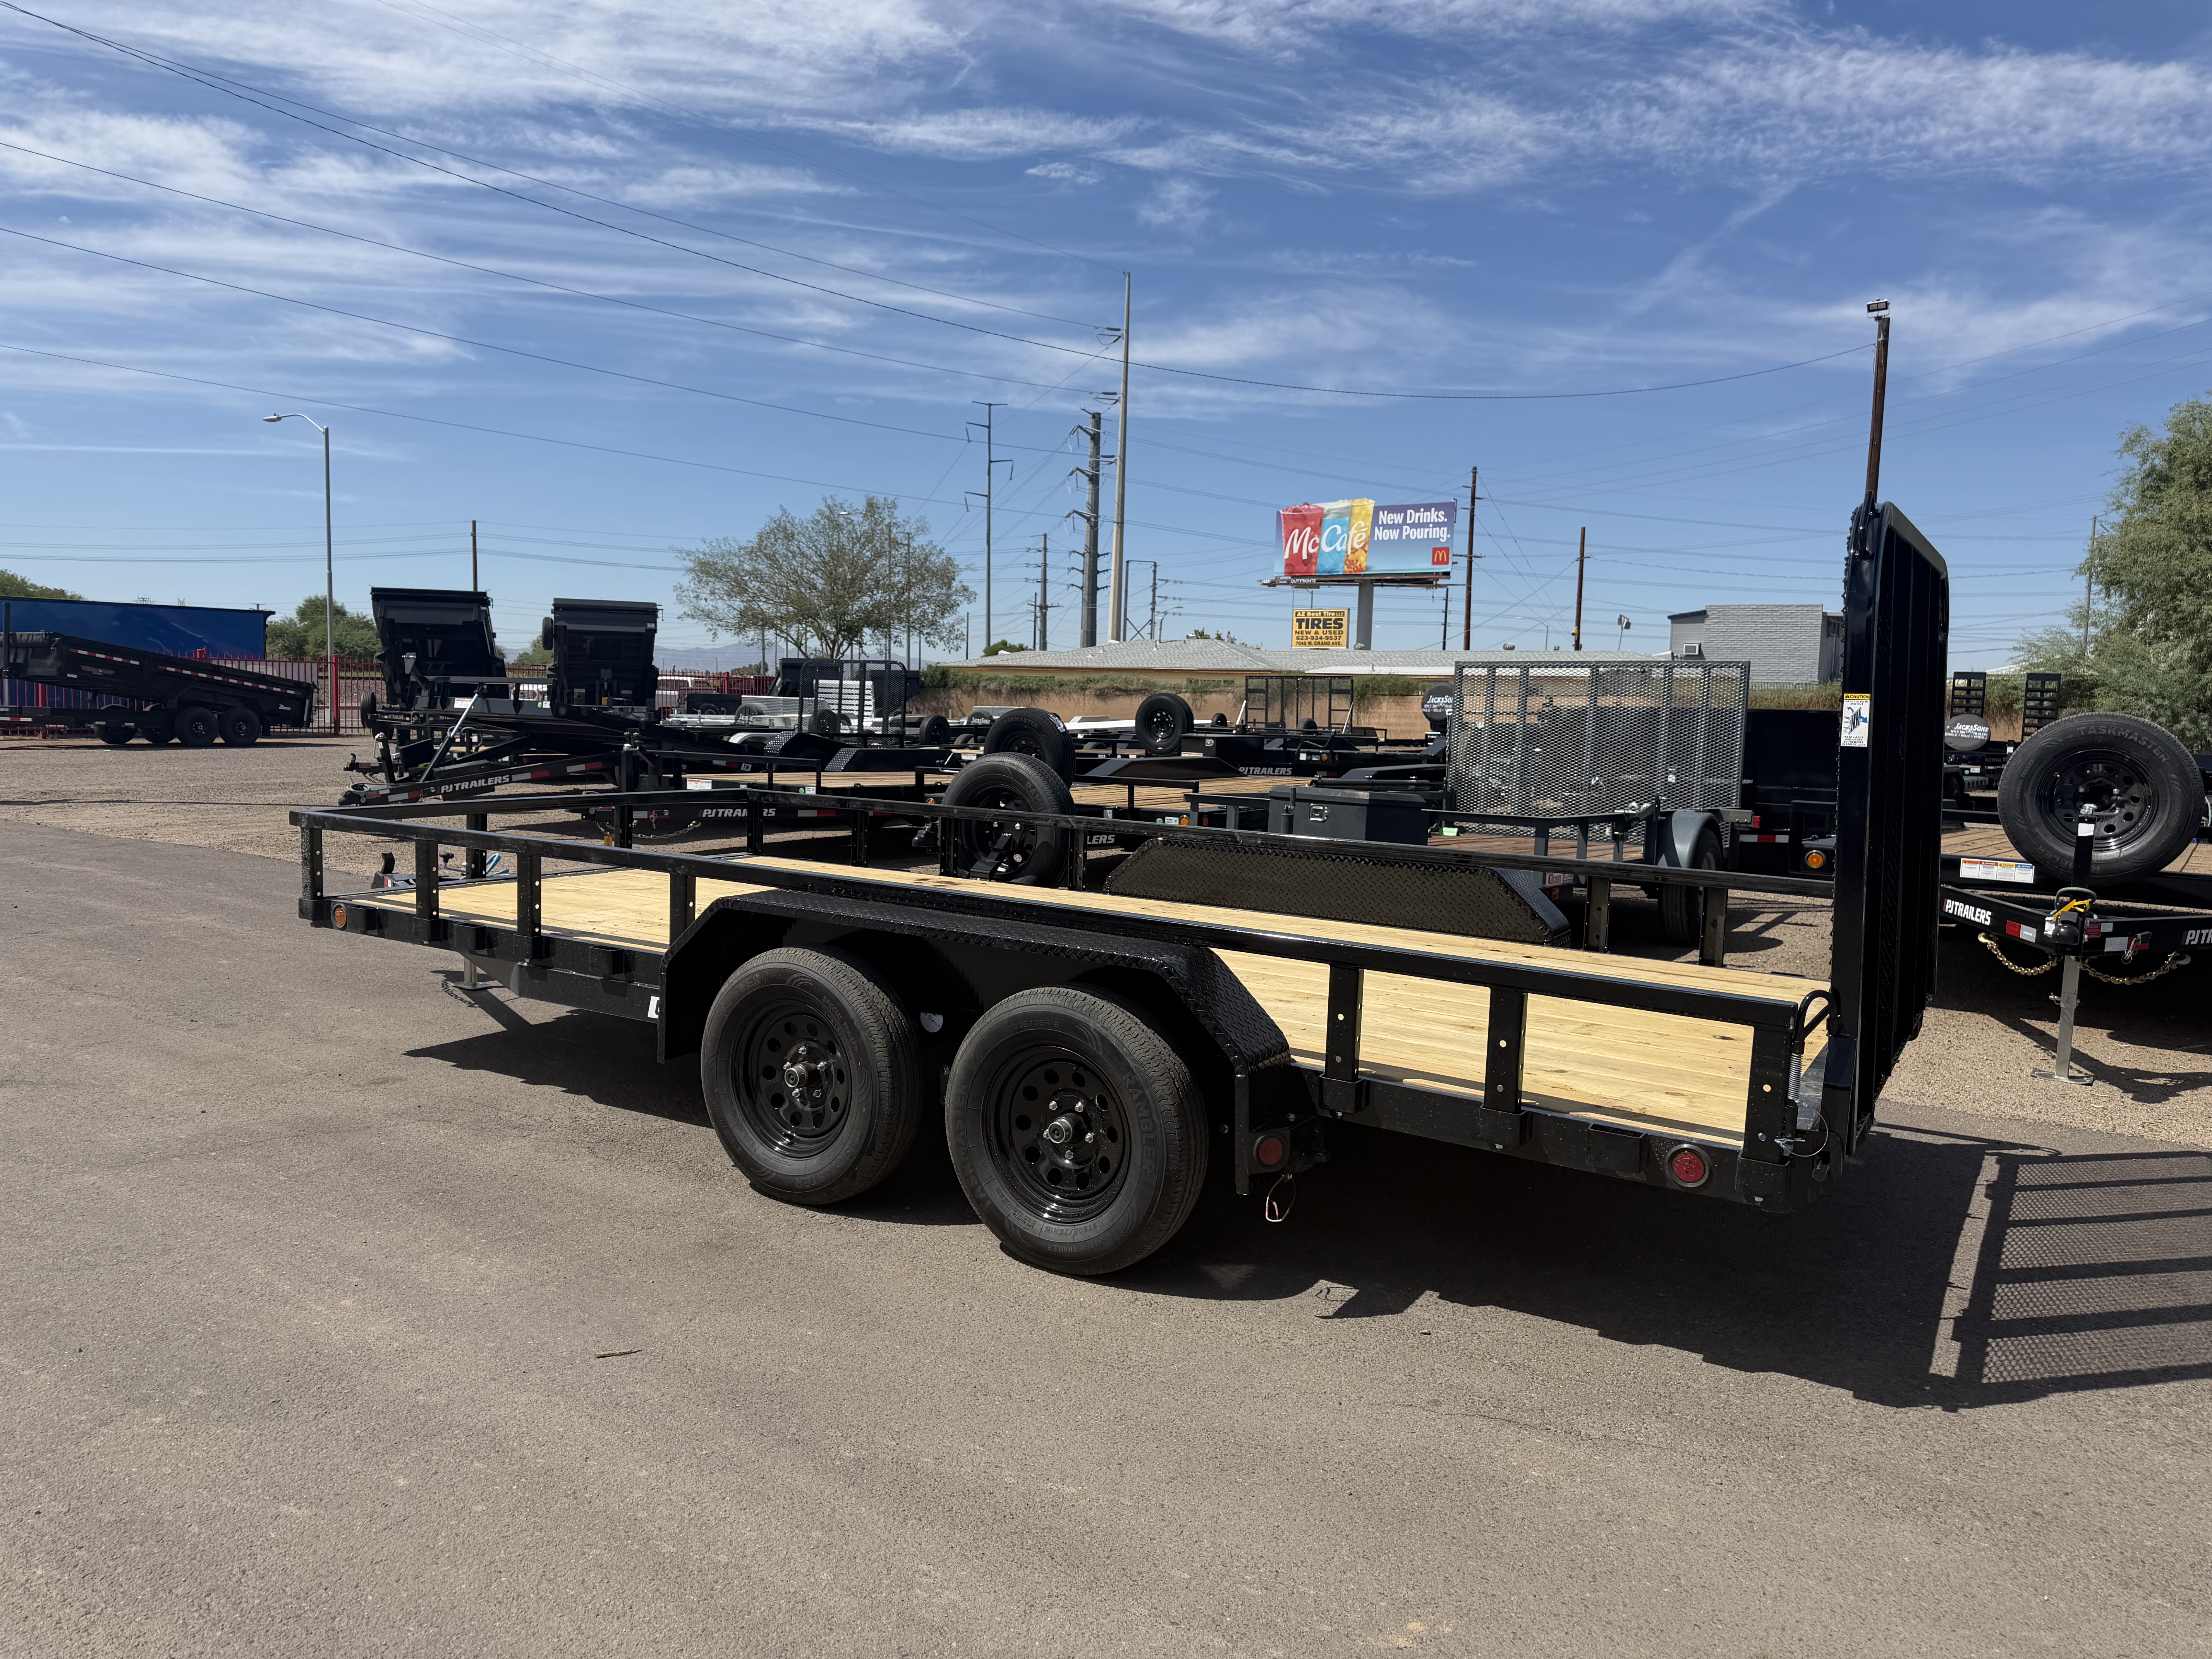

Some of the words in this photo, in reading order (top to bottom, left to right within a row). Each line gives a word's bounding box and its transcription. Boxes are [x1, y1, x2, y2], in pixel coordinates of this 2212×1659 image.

[1379, 510, 1403, 524] New
[1407, 508, 1448, 524] Drinks.
[1284, 520, 1367, 560] McCafé
[1374, 526, 1400, 540] Now
[1402, 524, 1451, 542] Pouring.
[1296, 618, 1343, 629] TIRES
[2077, 725, 2171, 763] TASKMASTER
[1249, 767, 1292, 775] TRAILERS
[454, 775, 510, 791] TRAILERS
[1026, 780, 1046, 812] RAMB
[717, 808, 776, 817] TRAIRS
[1954, 901, 1992, 926] TRAILERS
[822, 996, 843, 1022] SPECIAL
[842, 1021, 858, 1052] TRAILER
[1122, 1071, 1156, 1174] RAMBLER
[953, 1085, 991, 1209] TASKMASTER
[1047, 1243, 1077, 1253] TRAILER
[1080, 1237, 1108, 1251] SPECIAL
